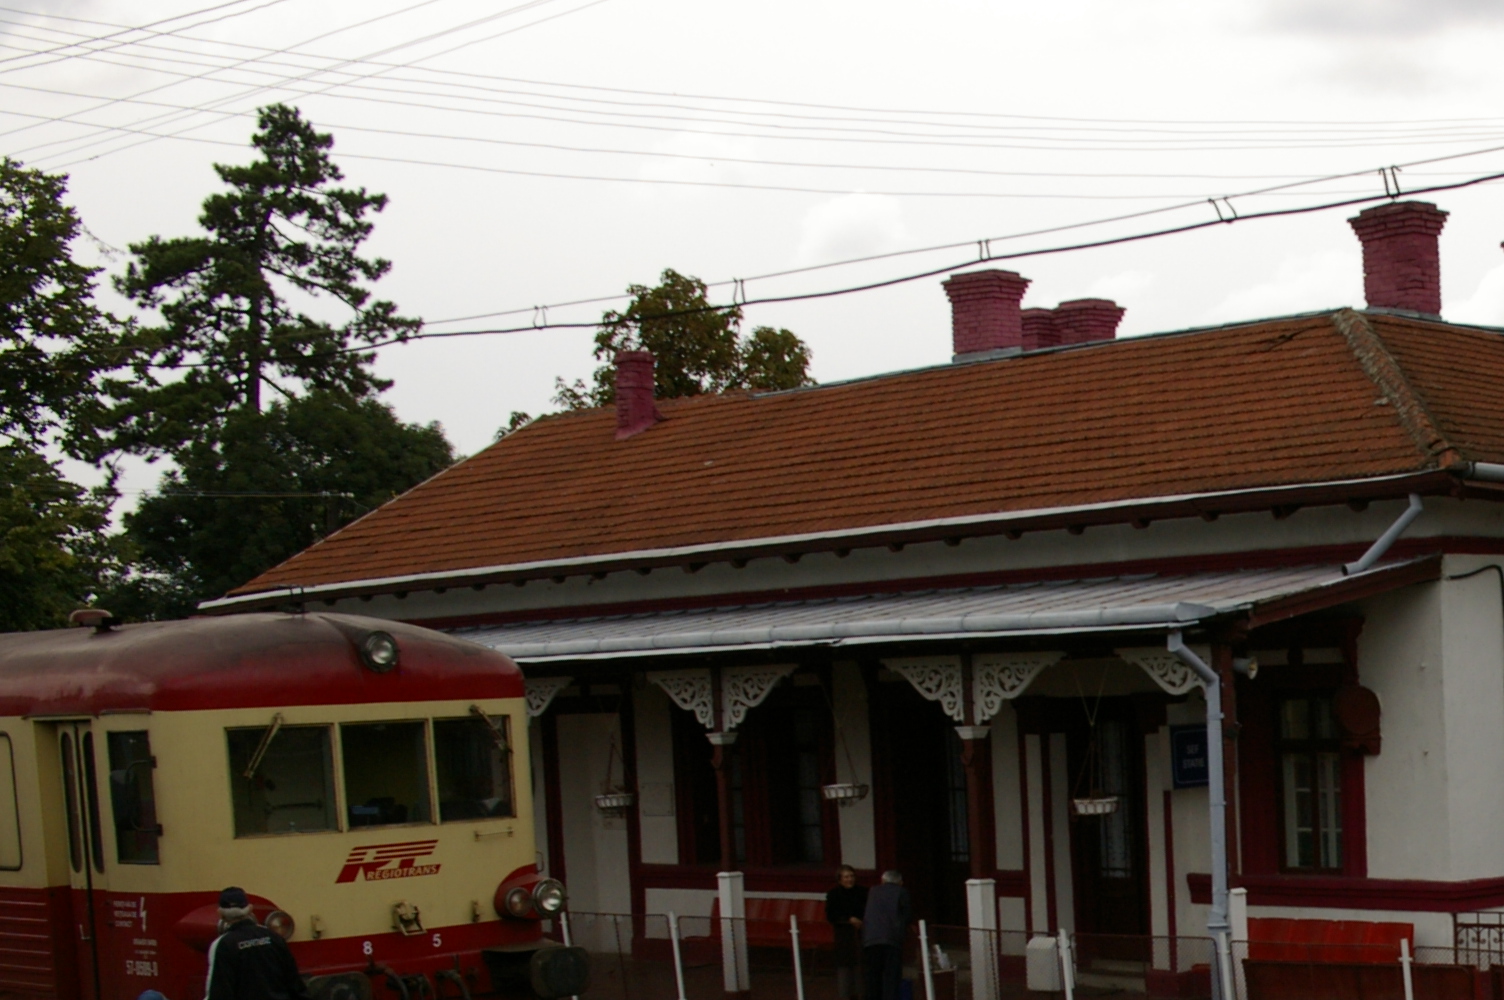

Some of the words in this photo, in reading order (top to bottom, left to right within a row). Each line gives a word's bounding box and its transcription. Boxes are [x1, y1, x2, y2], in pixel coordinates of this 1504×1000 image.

[366, 865, 438, 881] REGIOTRANS
[362, 940, 373, 955] 8
[432, 933, 442, 948] 5
